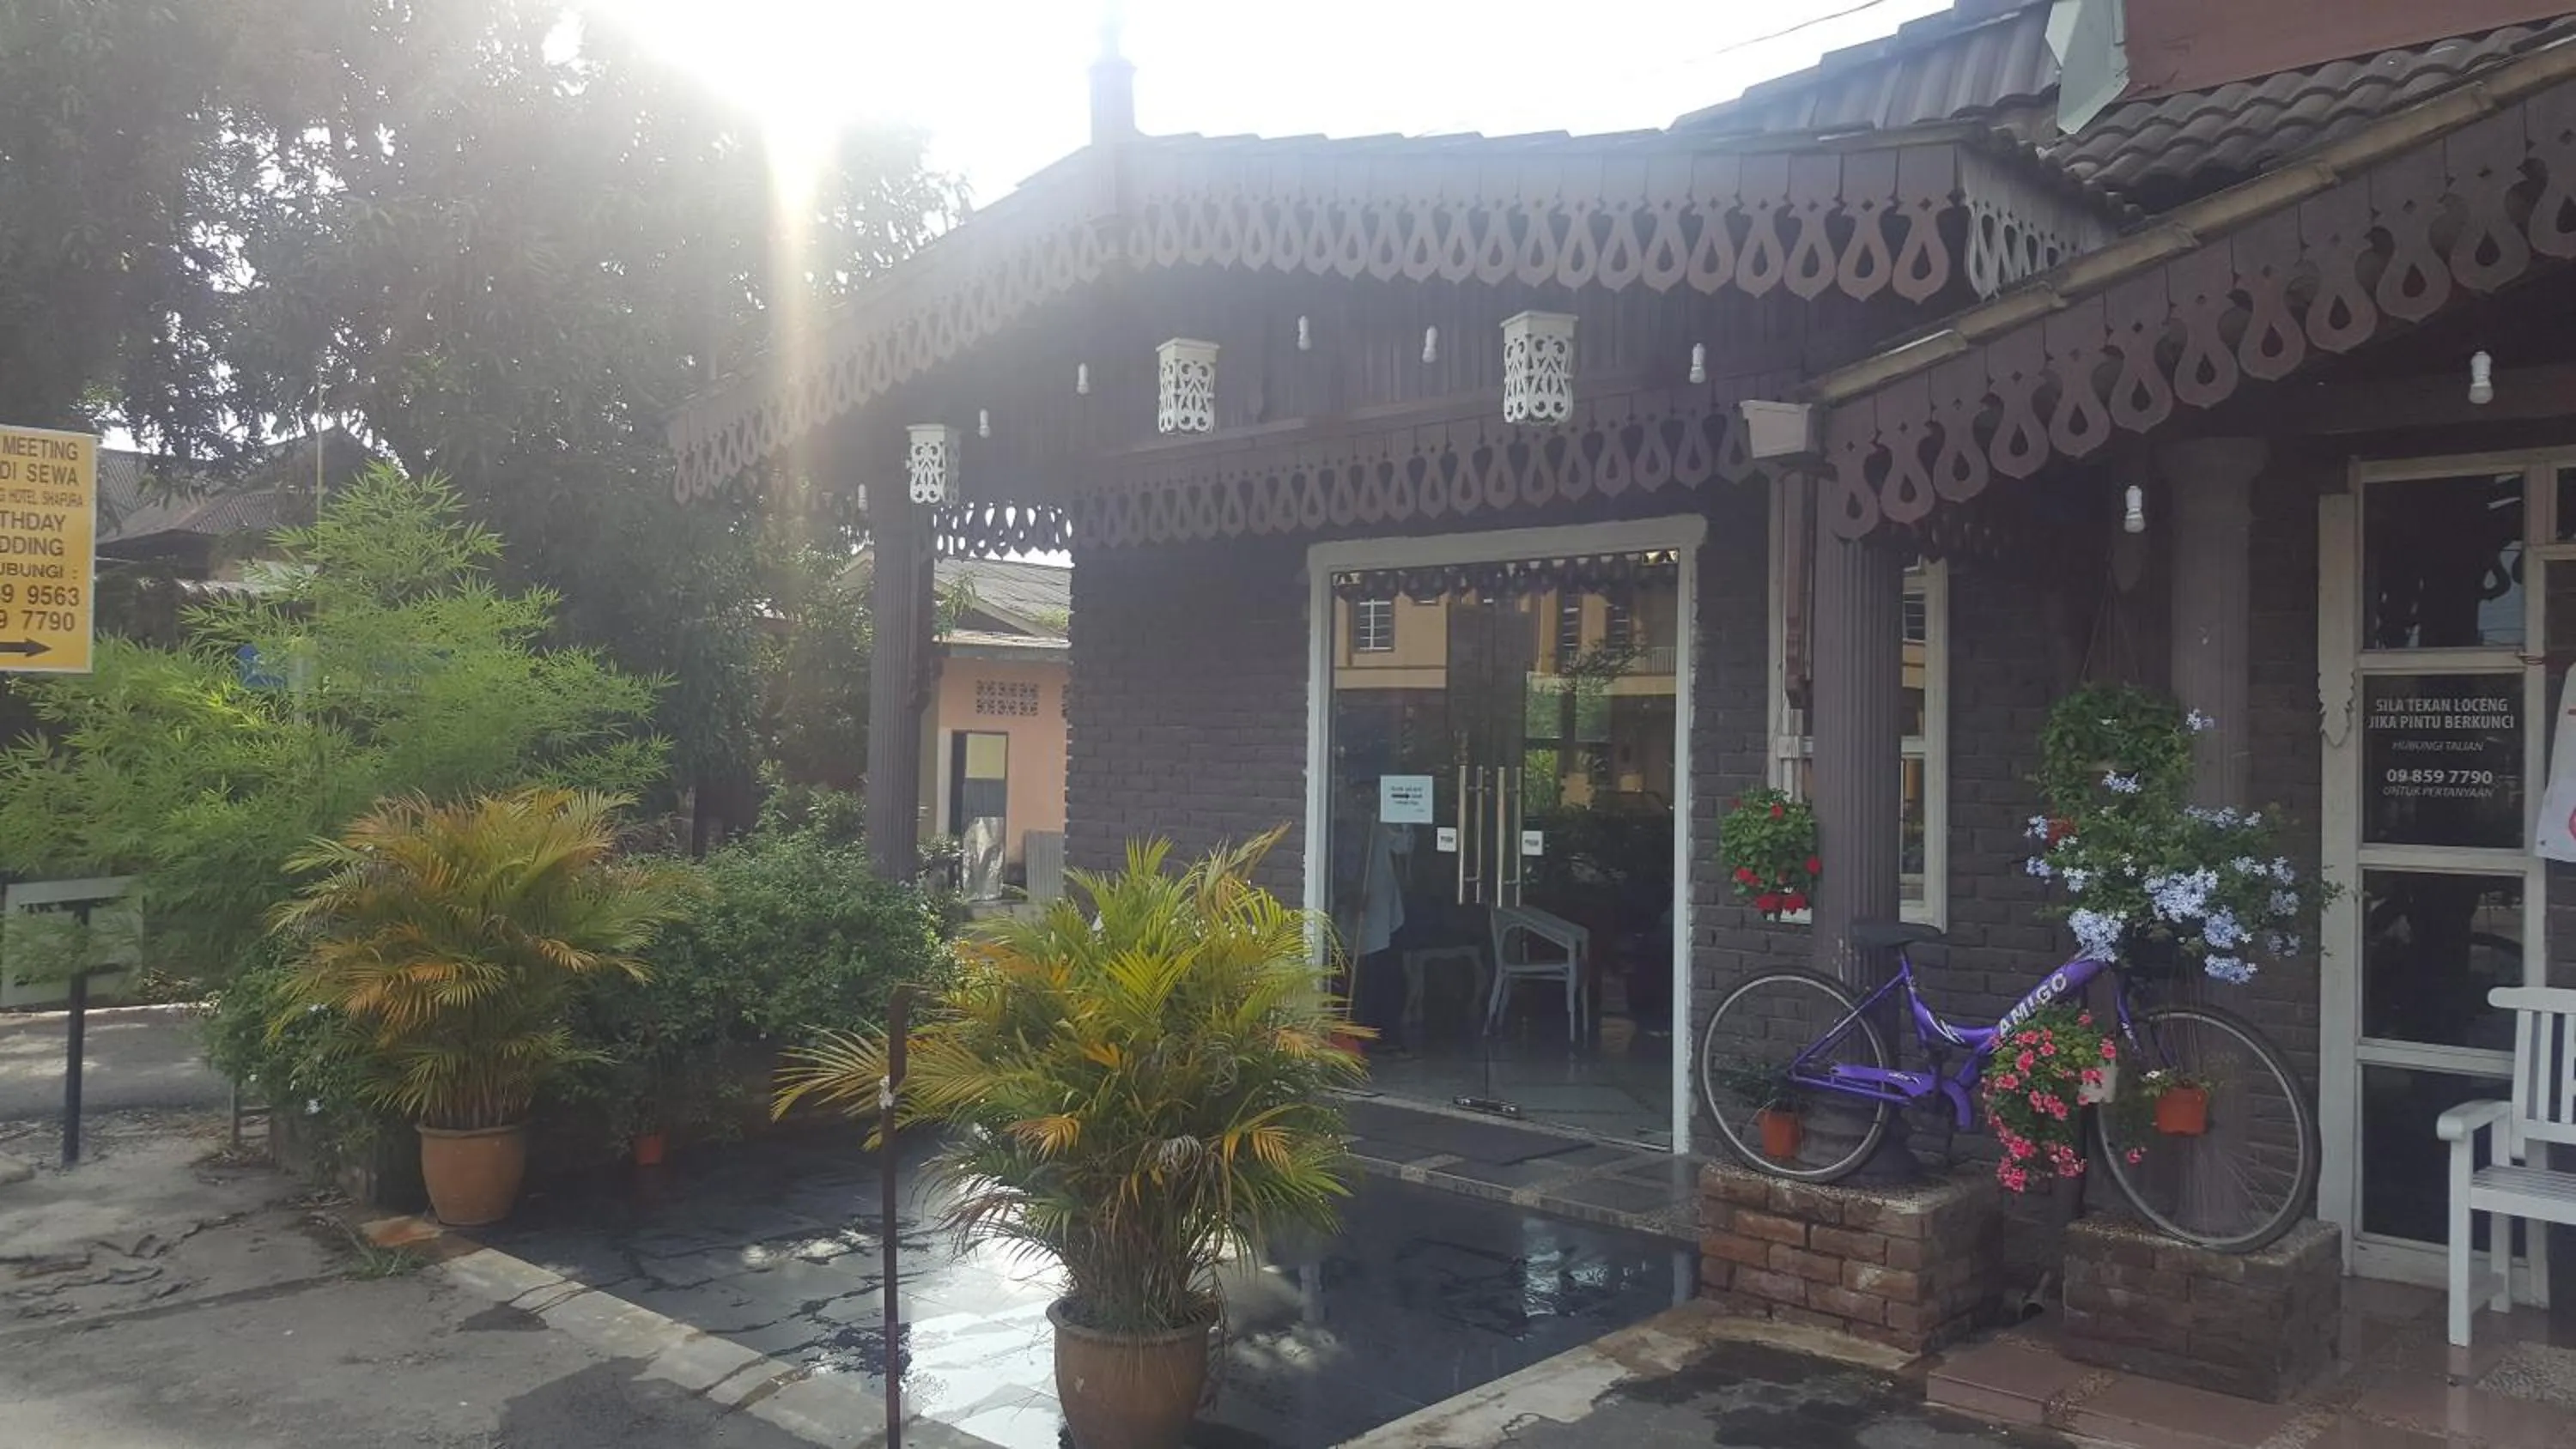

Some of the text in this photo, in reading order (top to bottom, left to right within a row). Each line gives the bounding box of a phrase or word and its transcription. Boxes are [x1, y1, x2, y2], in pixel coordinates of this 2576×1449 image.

[3, 435, 78, 461] MEETING
[27, 463, 80, 487] SEWA
[0, 510, 66, 533] THDAY
[0, 535, 64, 557] DDING
[27, 585, 81, 607] 9563
[21, 609, 76, 633] 7790
[2375, 698, 2509, 712] SILA TEKAN LOCENG
[2368, 715, 2515, 730] JIKA PINTU BERKUNCI
[2448, 770, 2493, 785] 7790
[1999, 972, 2068, 1039] AMIGO
